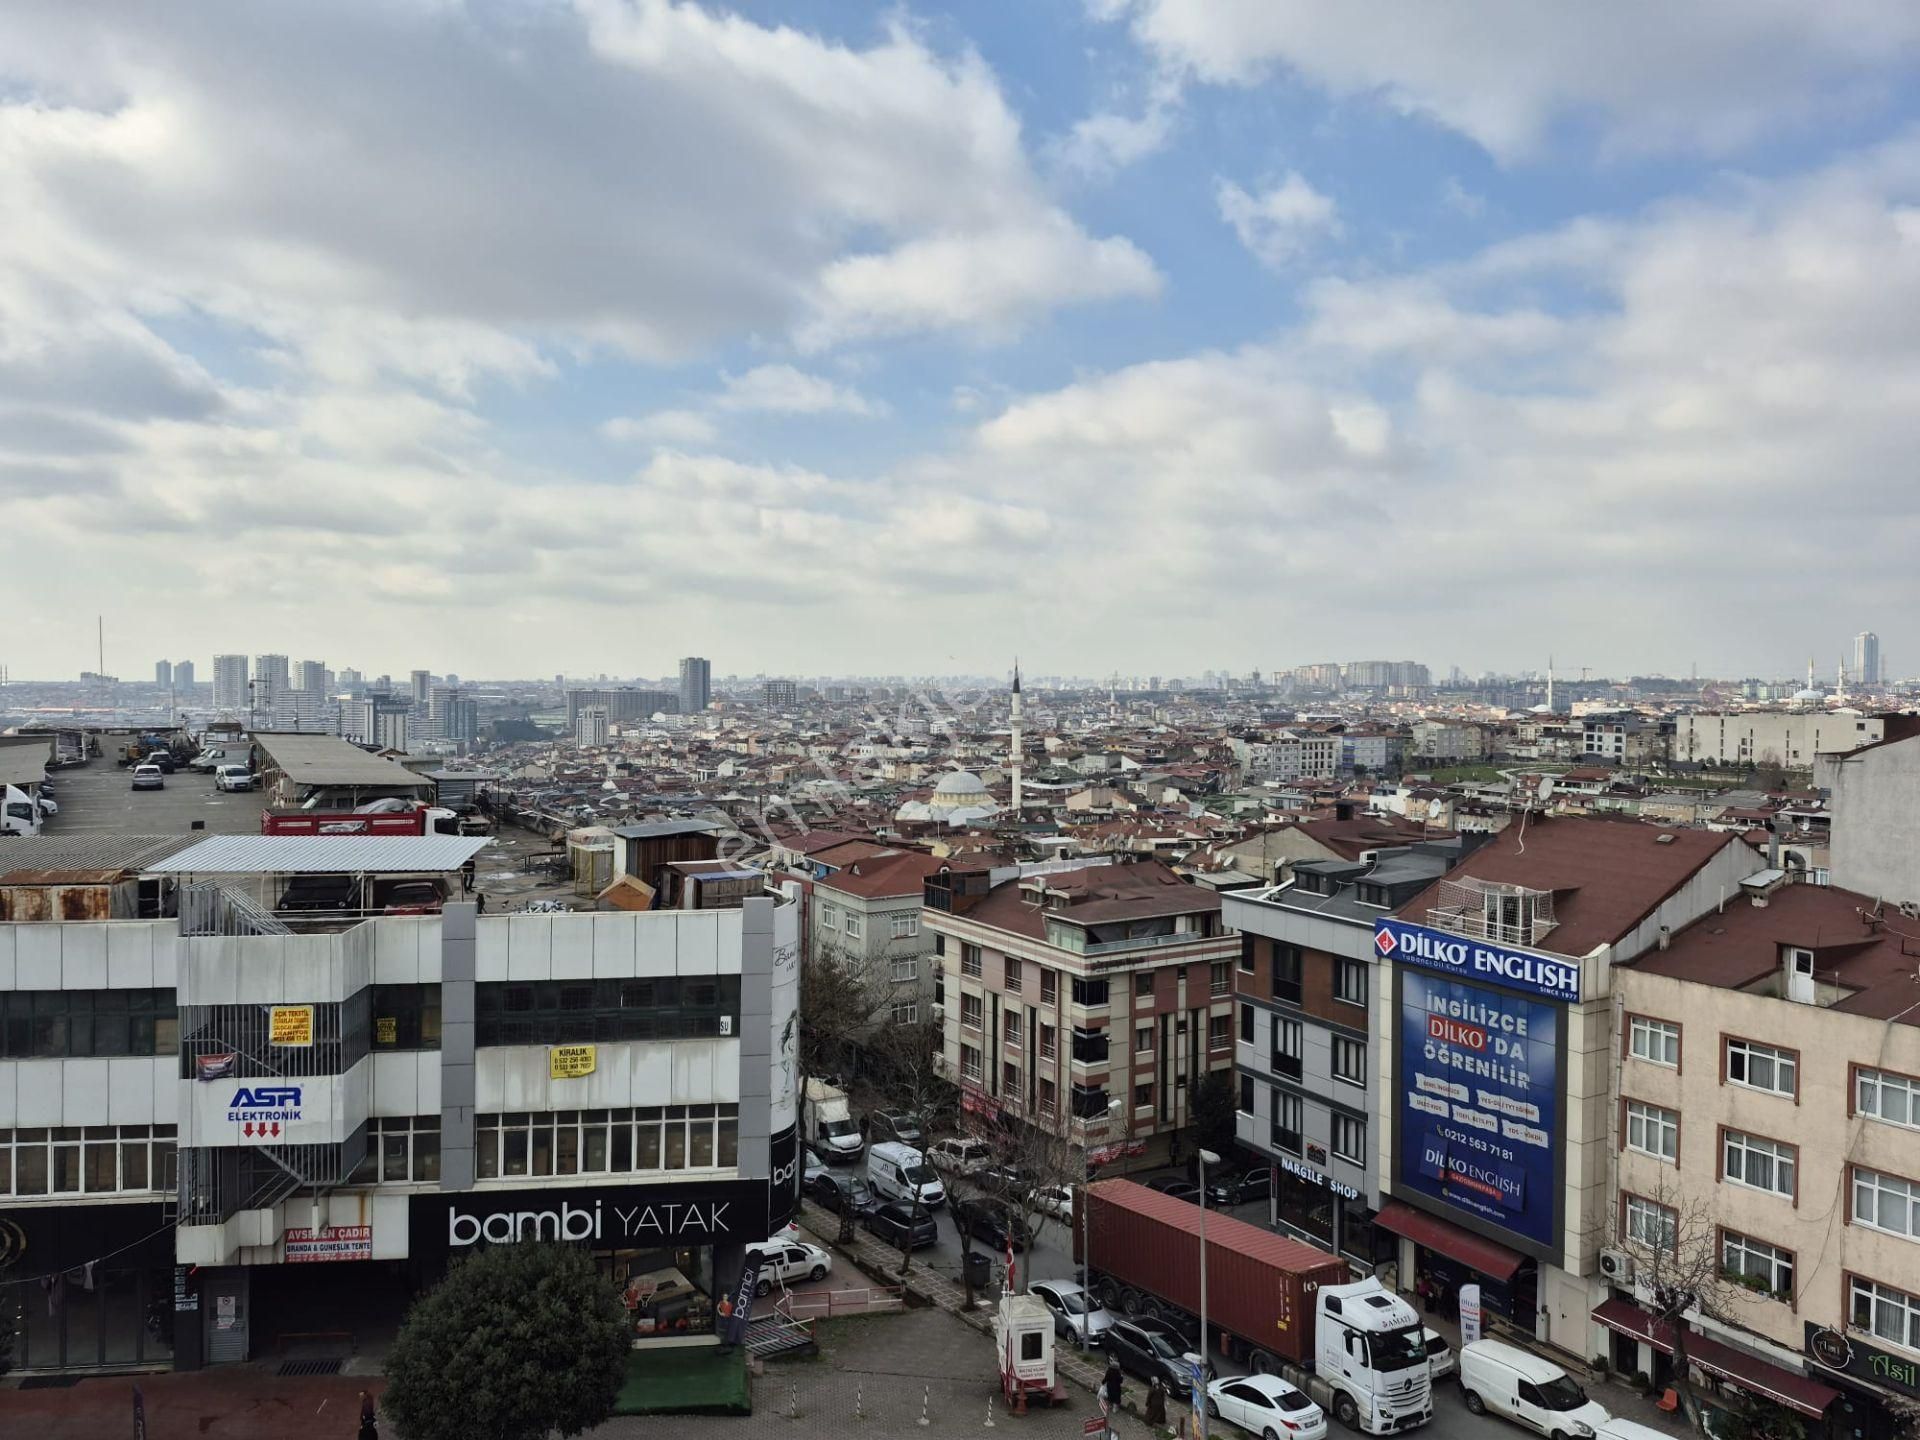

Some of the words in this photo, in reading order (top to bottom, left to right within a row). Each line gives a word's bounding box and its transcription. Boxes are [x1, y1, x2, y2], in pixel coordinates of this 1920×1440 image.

[1401, 933, 1469, 965] DİLKO
[1474, 949, 1577, 992] ENGLISH
[1539, 986, 1559, 997] SINCE
[1426, 989, 1528, 1037] İNGİLİZCE
[1423, 1039, 1530, 1091] ÖĞRENİLİR
[228, 1108, 302, 1121] ELEKTRONİK
[229, 1087, 302, 1108] ASR
[1444, 1128, 1467, 1145] 0212
[1469, 1137, 1488, 1152] 563
[1489, 1144, 1500, 1157] 71
[1502, 1149, 1513, 1162] 81
[1281, 1157, 1323, 1186] NARGİLE
[1330, 1180, 1358, 1200] SHOP
[1469, 1164, 1521, 1197] ENGLISH
[449, 1199, 602, 1247] bambi
[614, 1202, 730, 1237] YATAK
[351, 1242, 371, 1250] TENTE
[733, 1267, 755, 1320] bambi
[1867, 1354, 1916, 1388] Asil
